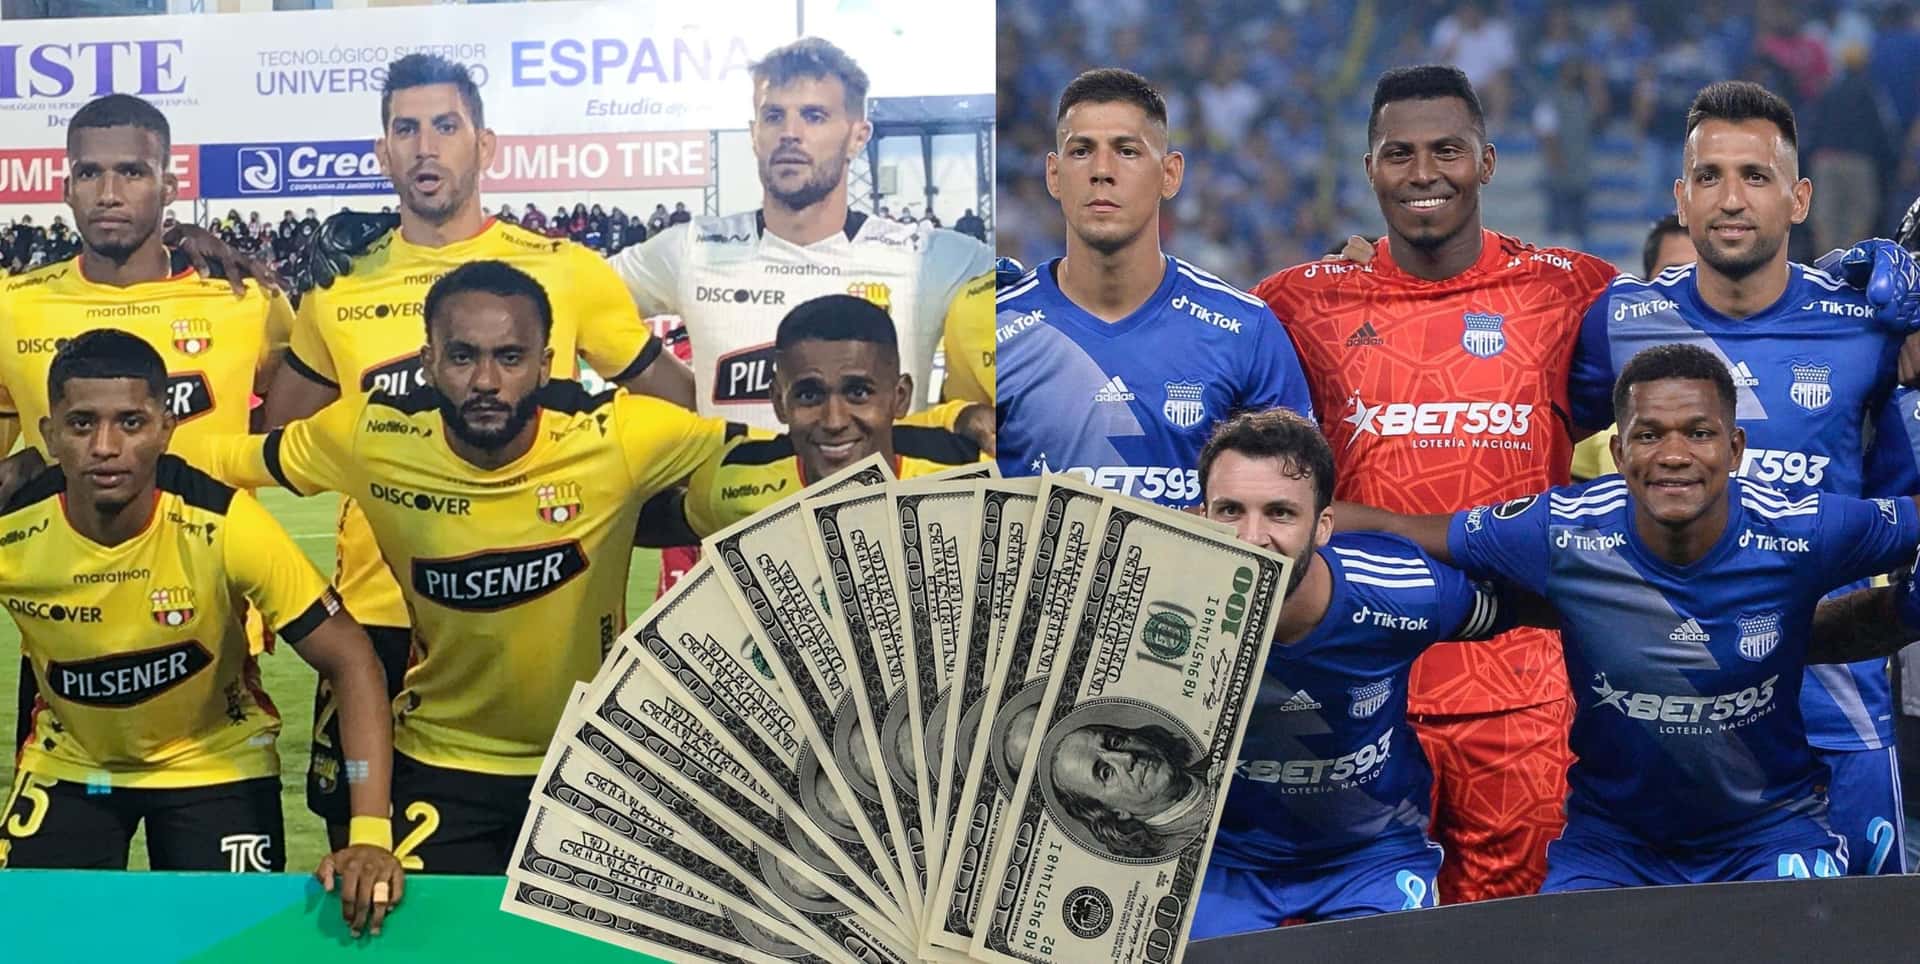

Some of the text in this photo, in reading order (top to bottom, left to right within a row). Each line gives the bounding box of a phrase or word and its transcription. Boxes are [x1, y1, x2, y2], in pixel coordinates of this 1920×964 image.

[258, 46, 389, 66] TECNOLÓGICO
[585, 98, 662, 117] Estudia
[616, 139, 705, 177] TIRE
[765, 263, 840, 276] marathon
[86, 303, 160, 318] marathon
[696, 286, 785, 304] DISCOVER
[1630, 300, 1681, 318] TikTok
[1820, 300, 1876, 319] TikTok
[337, 303, 424, 322] DISCOVER
[1189, 302, 1243, 334] TikTok
[1346, 336, 1384, 348] adidas
[1094, 391, 1135, 402] adidas
[1379, 402, 1533, 436] BET593
[1412, 438, 1533, 451] LOTERÍA NACIONAL
[370, 483, 471, 515] DISCOVER
[1575, 532, 1628, 550] TikTok
[1755, 535, 1810, 552] TikTok
[424, 551, 565, 600] PILSENER
[849, 528, 883, 607] STATES
[927, 521, 950, 599] STATES
[73, 568, 150, 585] marathon
[8, 598, 103, 623] DISCOVER
[772, 559, 836, 649] AMERICA
[1034, 596, 1069, 675] UNITED
[1052, 520, 1087, 598] STATES
[1111, 563, 1151, 658] AMERICA
[1217, 563, 1256, 639] 100
[753, 551, 849, 699] UNITED STATES
[1086, 544, 1142, 699] UNITED STATES
[1371, 611, 1429, 631] TikTok
[1669, 630, 1710, 642] adidas
[871, 605, 906, 685] UNITED
[1186, 606, 1217, 678] 94571448
[62, 651, 188, 697] PILSENER
[676, 630, 743, 697] STATES
[697, 632, 778, 712] AMERICA
[1211, 727, 1229, 763] ONE
[1221, 643, 1254, 727] HUNDRED
[1244, 567, 1275, 642] DOLLARS
[1180, 677, 1197, 698] KB
[1626, 675, 1779, 723] BET593
[734, 689, 802, 756] UNITED
[1280, 702, 1323, 712] adidas
[1660, 703, 1777, 735] LOTERÍA NACIONAL
[637, 696, 711, 755] STATES
[1245, 727, 1394, 784] BET593
[557, 838, 639, 876] STATES
[1027, 852, 1060, 928] 94571448
[1022, 929, 1038, 949] KB
[1039, 935, 1055, 955] B2
